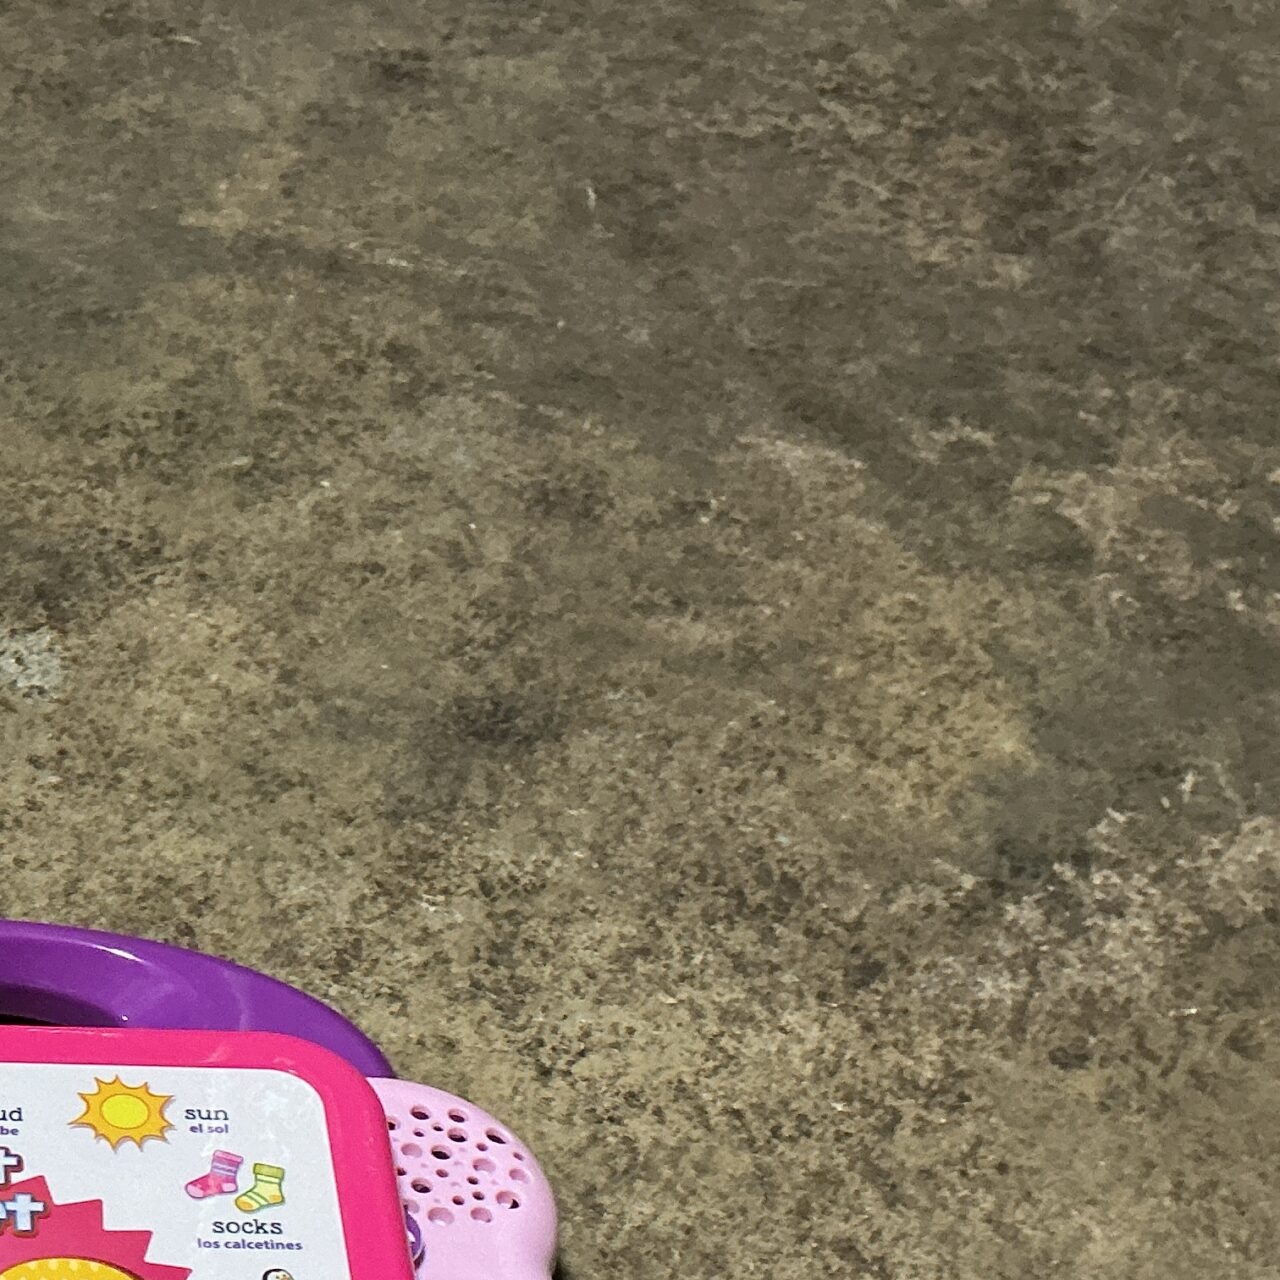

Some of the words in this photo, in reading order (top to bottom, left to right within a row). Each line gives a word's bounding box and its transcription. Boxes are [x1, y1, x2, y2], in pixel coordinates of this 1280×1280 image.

[184, 1106, 229, 1121] sun
[189, 1123, 205, 1134] el
[207, 1123, 229, 1134] sol
[212, 1219, 283, 1235] socks
[197, 1238, 220, 1249] los
[224, 1238, 303, 1250] calcetines
